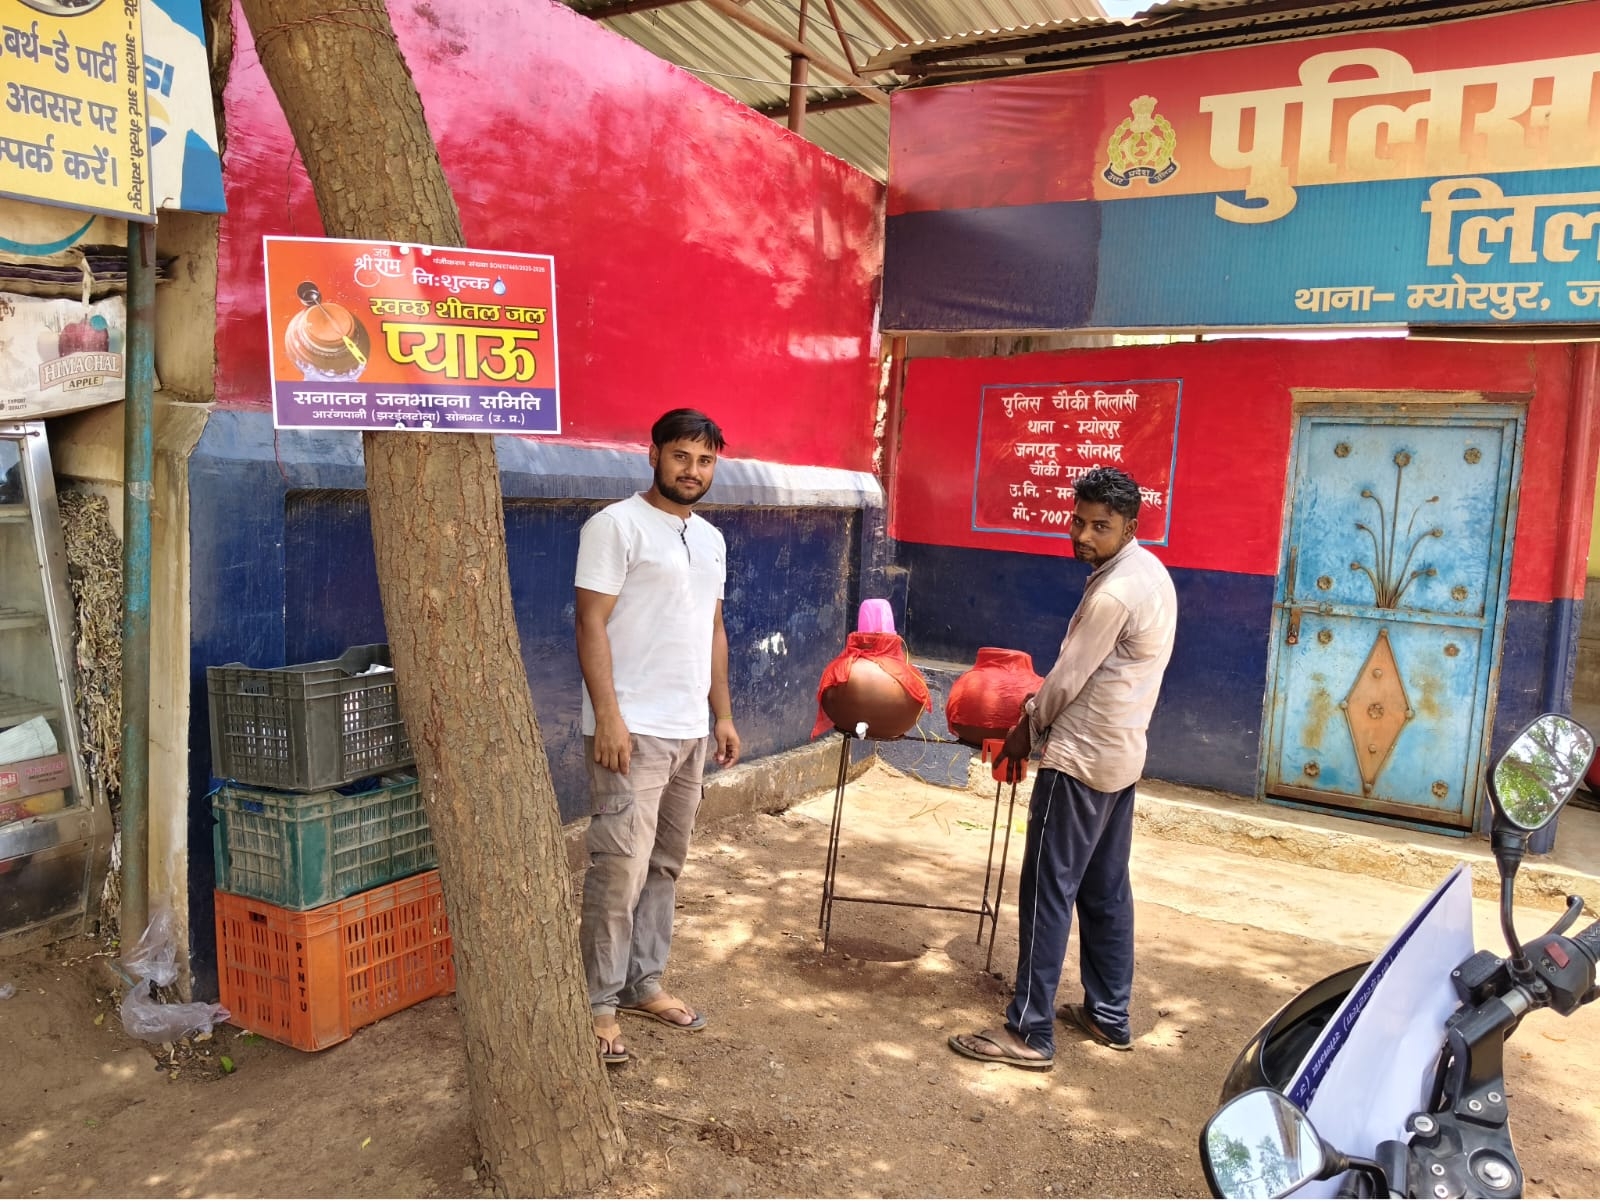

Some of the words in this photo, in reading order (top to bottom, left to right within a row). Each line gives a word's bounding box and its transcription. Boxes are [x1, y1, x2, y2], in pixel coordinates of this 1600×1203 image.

[75, 41, 118, 83] पार्टी
[6, 82, 83, 127] अवसर
[87, 101, 118, 134] पर
[375, 258, 404, 277] राम
[1407, 273, 1551, 320] म्योरपुर,
[369, 298, 431, 317] स्वच्छ
[435, 297, 502, 321] शीतल
[505, 306, 547, 324] जल
[382, 321, 539, 382] प्याऊ
[43, 355, 119, 383] HIMACHAL
[69, 376, 99, 389] APPLE
[293, 391, 367, 407] सनातन
[376, 391, 472, 410] जनभावना
[480, 390, 542, 411] समिति
[1001, 392, 1044, 418] पुलिस
[1052, 389, 1090, 411] चौकी
[1093, 388, 1139, 418] लिलासी
[1027, 420, 1055, 435] थाना
[1077, 416, 1123, 439] म्योरपुर
[1014, 442, 1061, 461] जनपद
[1077, 439, 1124, 463] सोनभद्र
[1029, 460, 1061, 477] चौकी
